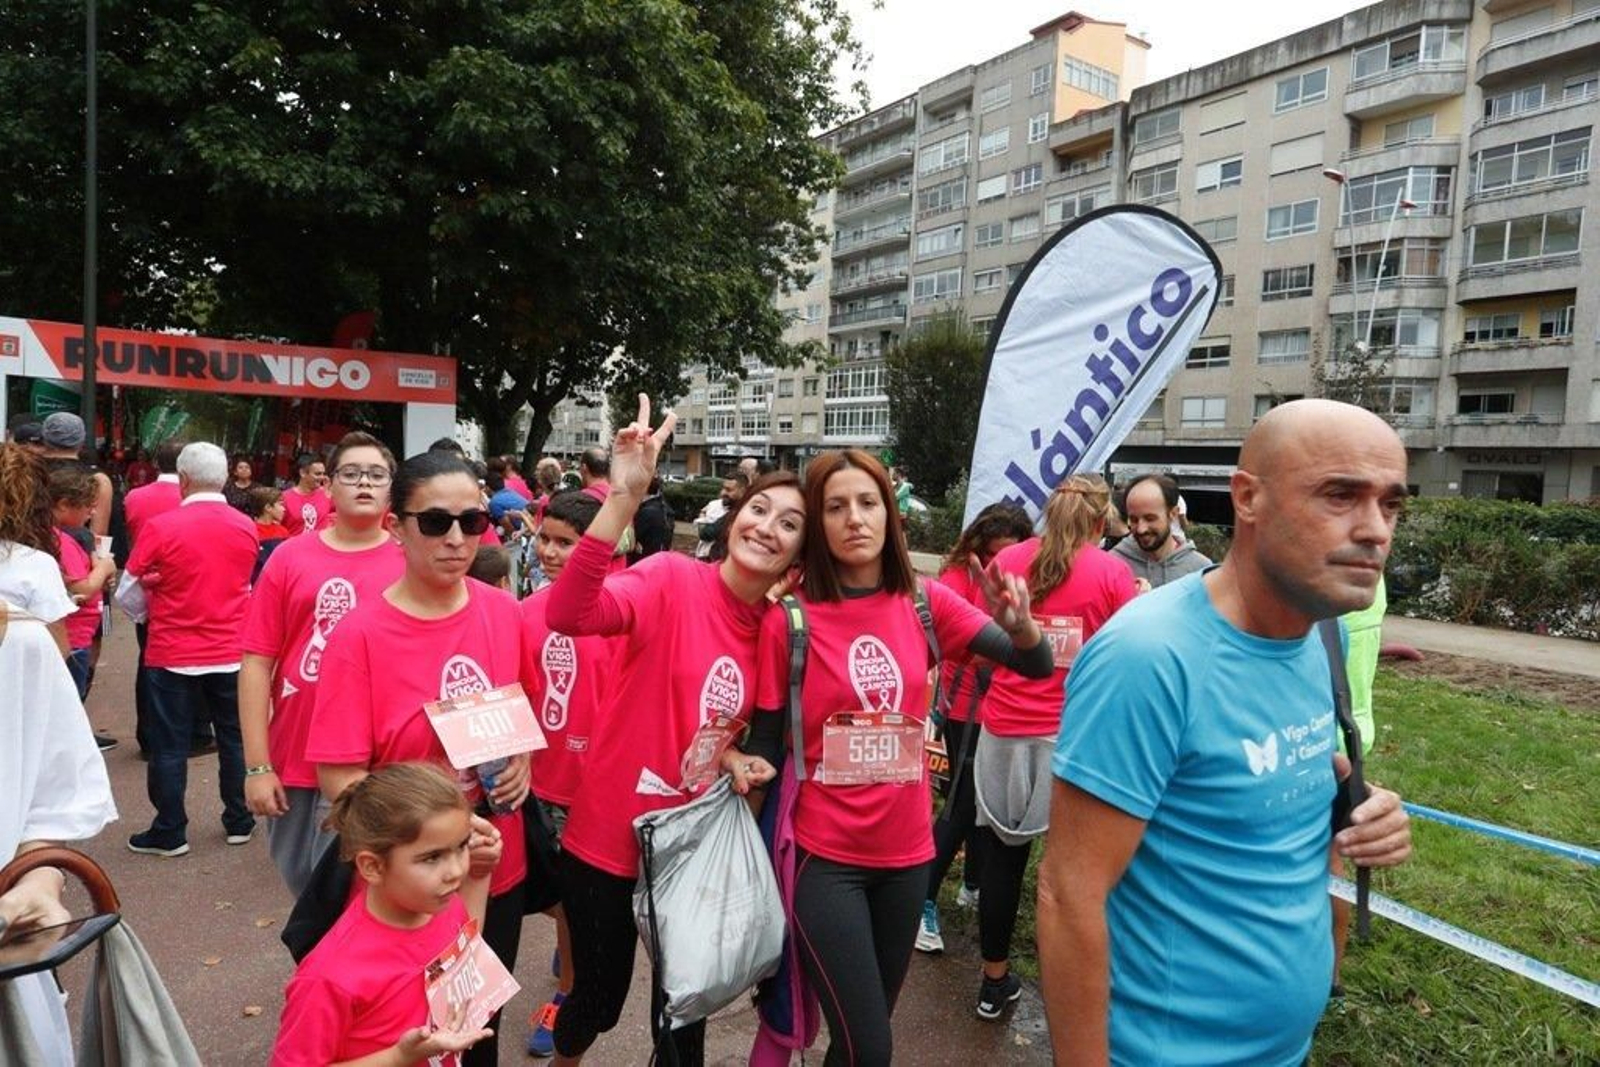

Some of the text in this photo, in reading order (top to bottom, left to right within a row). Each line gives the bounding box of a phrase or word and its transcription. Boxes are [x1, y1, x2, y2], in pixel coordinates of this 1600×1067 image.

[858, 644, 877, 658] VI
[449, 663, 470, 680] VI
[721, 664, 736, 681] VI
[857, 663, 891, 676] VIGO
[448, 682, 484, 699] VIGO
[711, 681, 738, 701] VIGO
[1281, 724, 1309, 743] Vigo
[849, 733, 900, 763] 5591
[1285, 747, 1296, 767] el
